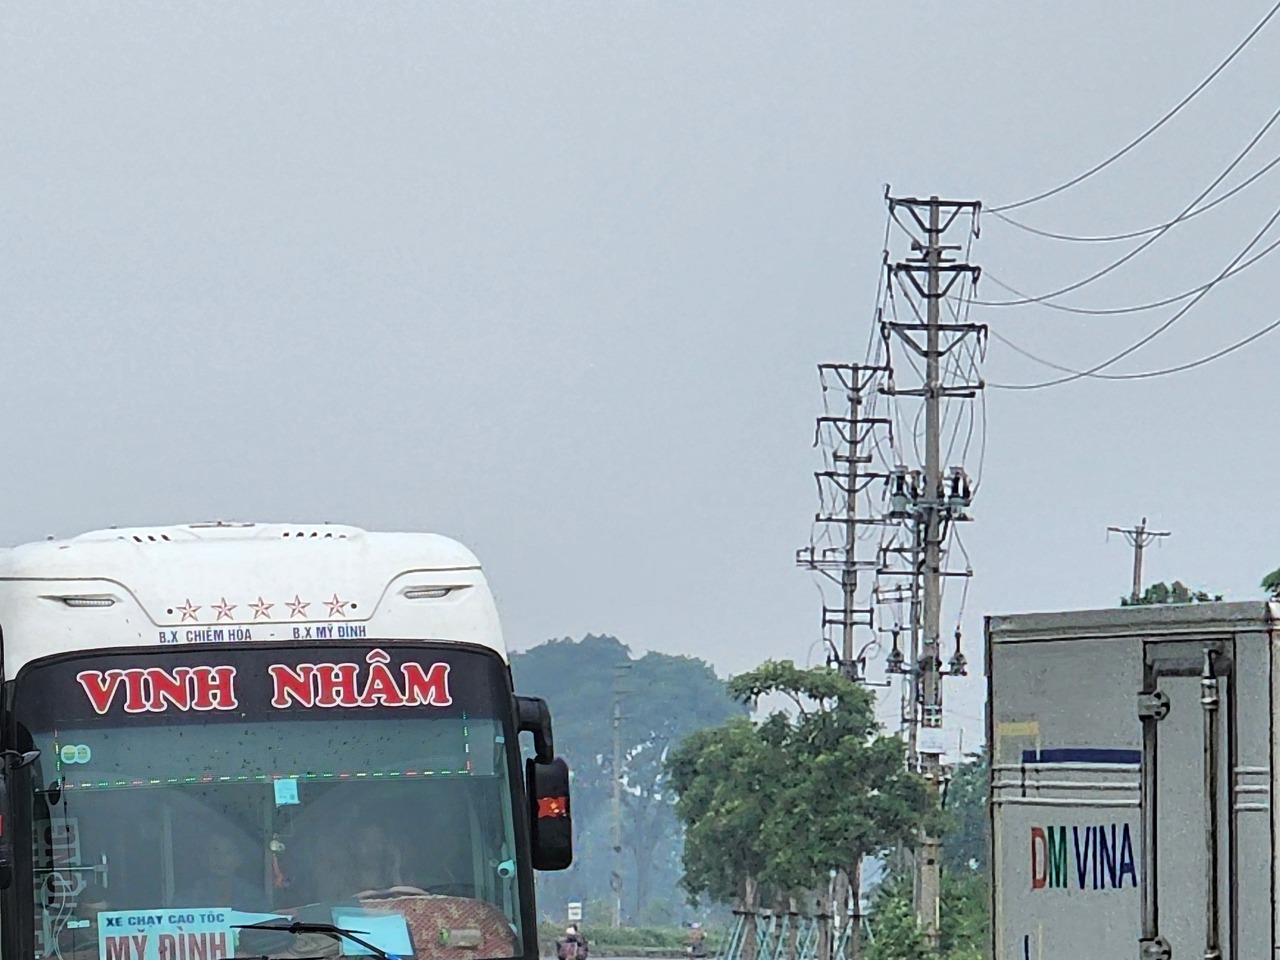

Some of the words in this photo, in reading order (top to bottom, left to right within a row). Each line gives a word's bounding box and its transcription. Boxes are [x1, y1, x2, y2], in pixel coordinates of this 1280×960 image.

[159, 631, 178, 643] B.X
[186, 627, 224, 642] CHIÊM
[228, 626, 252, 641] HÓA
[293, 626, 312, 639] B.X
[316, 623, 333, 638] MỸ
[337, 623, 367, 638] ĐÌNH
[76, 665, 238, 715] VINH
[268, 648, 453, 710] NHÂM
[1073, 823, 1138, 890] VINA
[106, 917, 123, 927] XE
[168, 913, 195, 924] CAO
